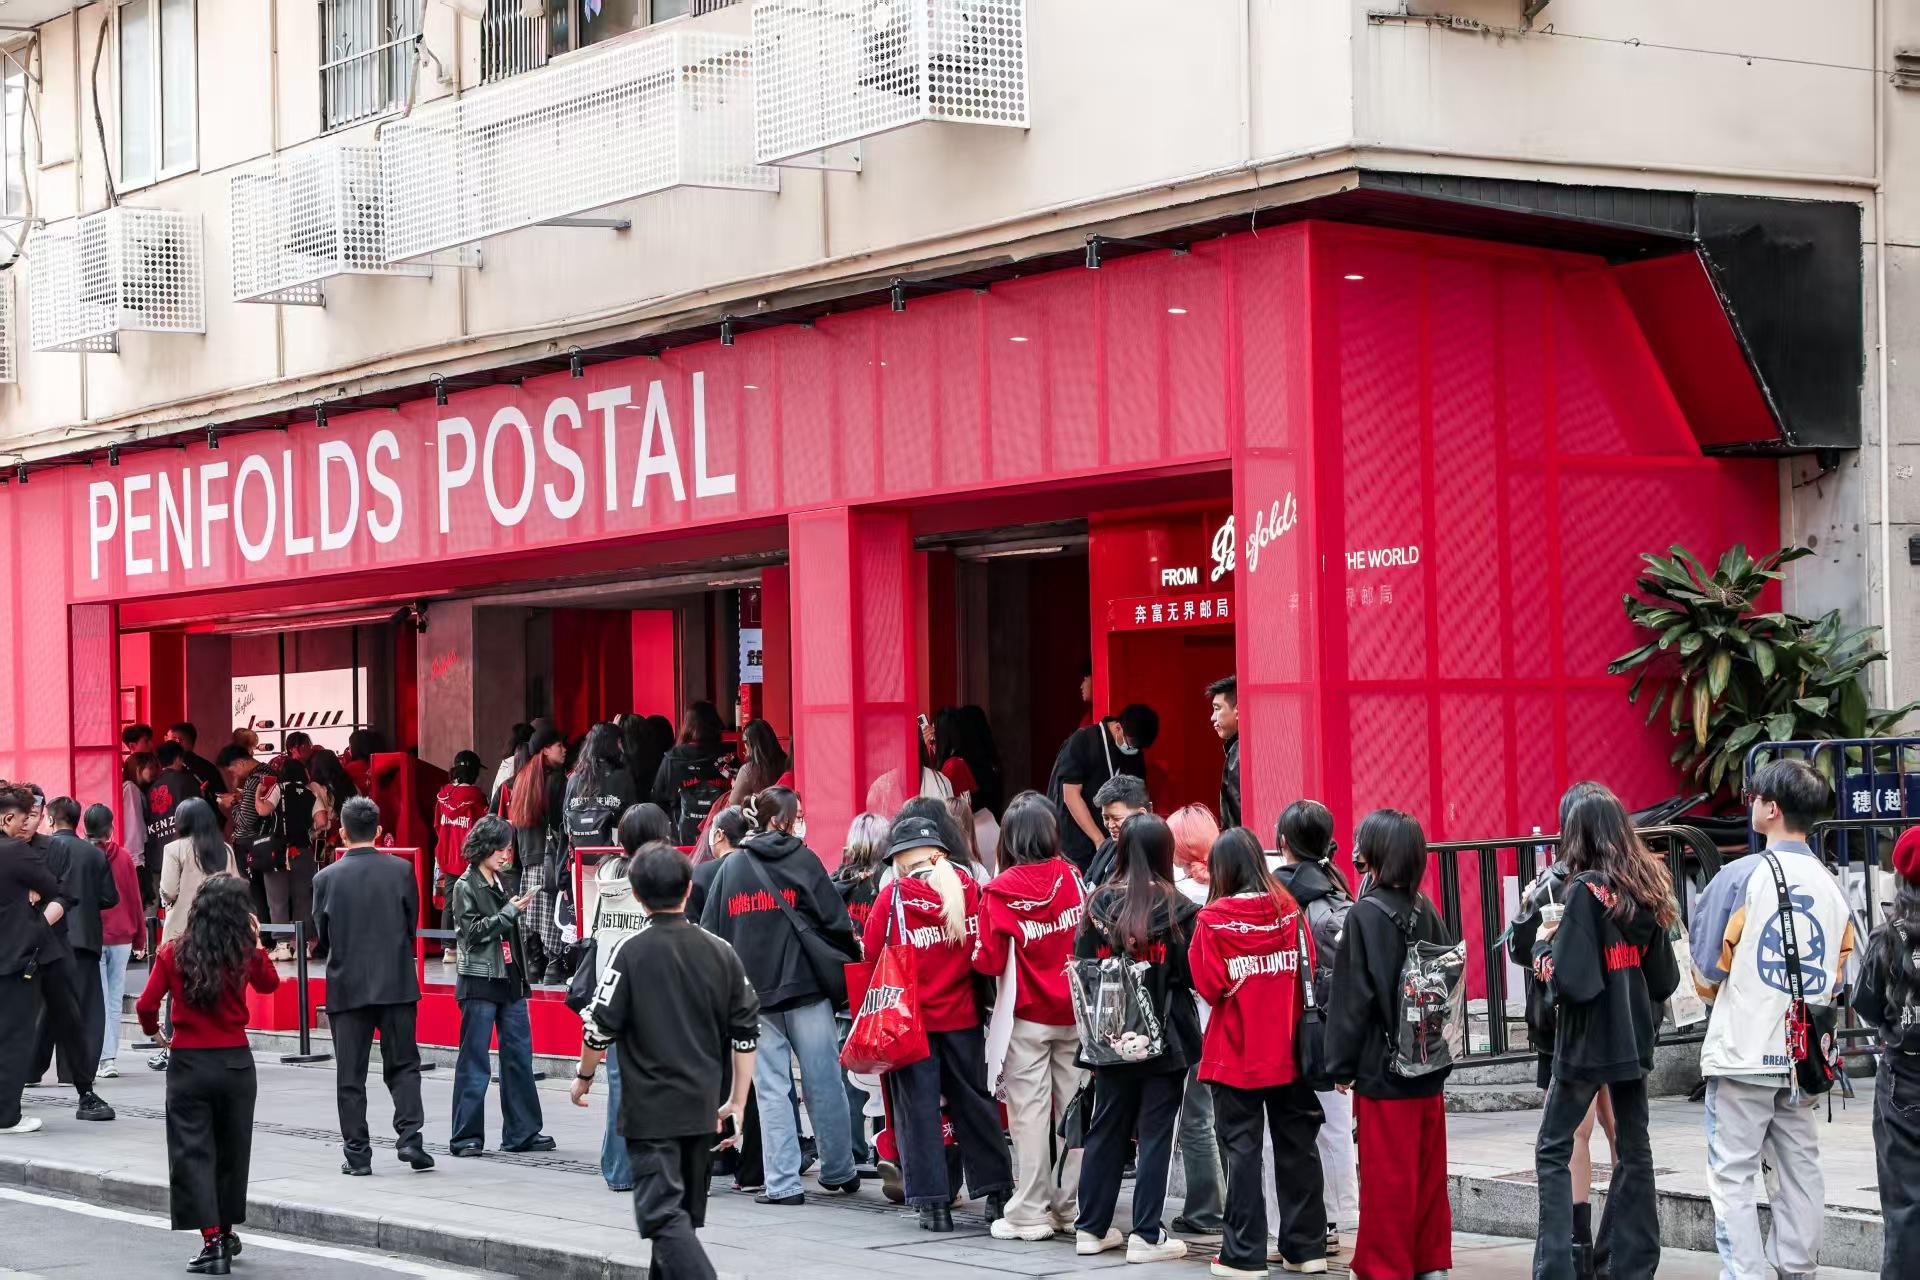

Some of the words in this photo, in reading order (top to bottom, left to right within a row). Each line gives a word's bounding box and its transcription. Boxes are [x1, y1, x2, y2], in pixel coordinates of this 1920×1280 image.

[89, 428, 402, 580] PENFOLDS
[438, 372, 736, 533] POSTAL
[1161, 566, 1198, 587] FROM
[1368, 546, 1419, 568] WORLD
[1135, 598, 1229, 624] 奔富无界邮局
[147, 815, 176, 835] KENZ
